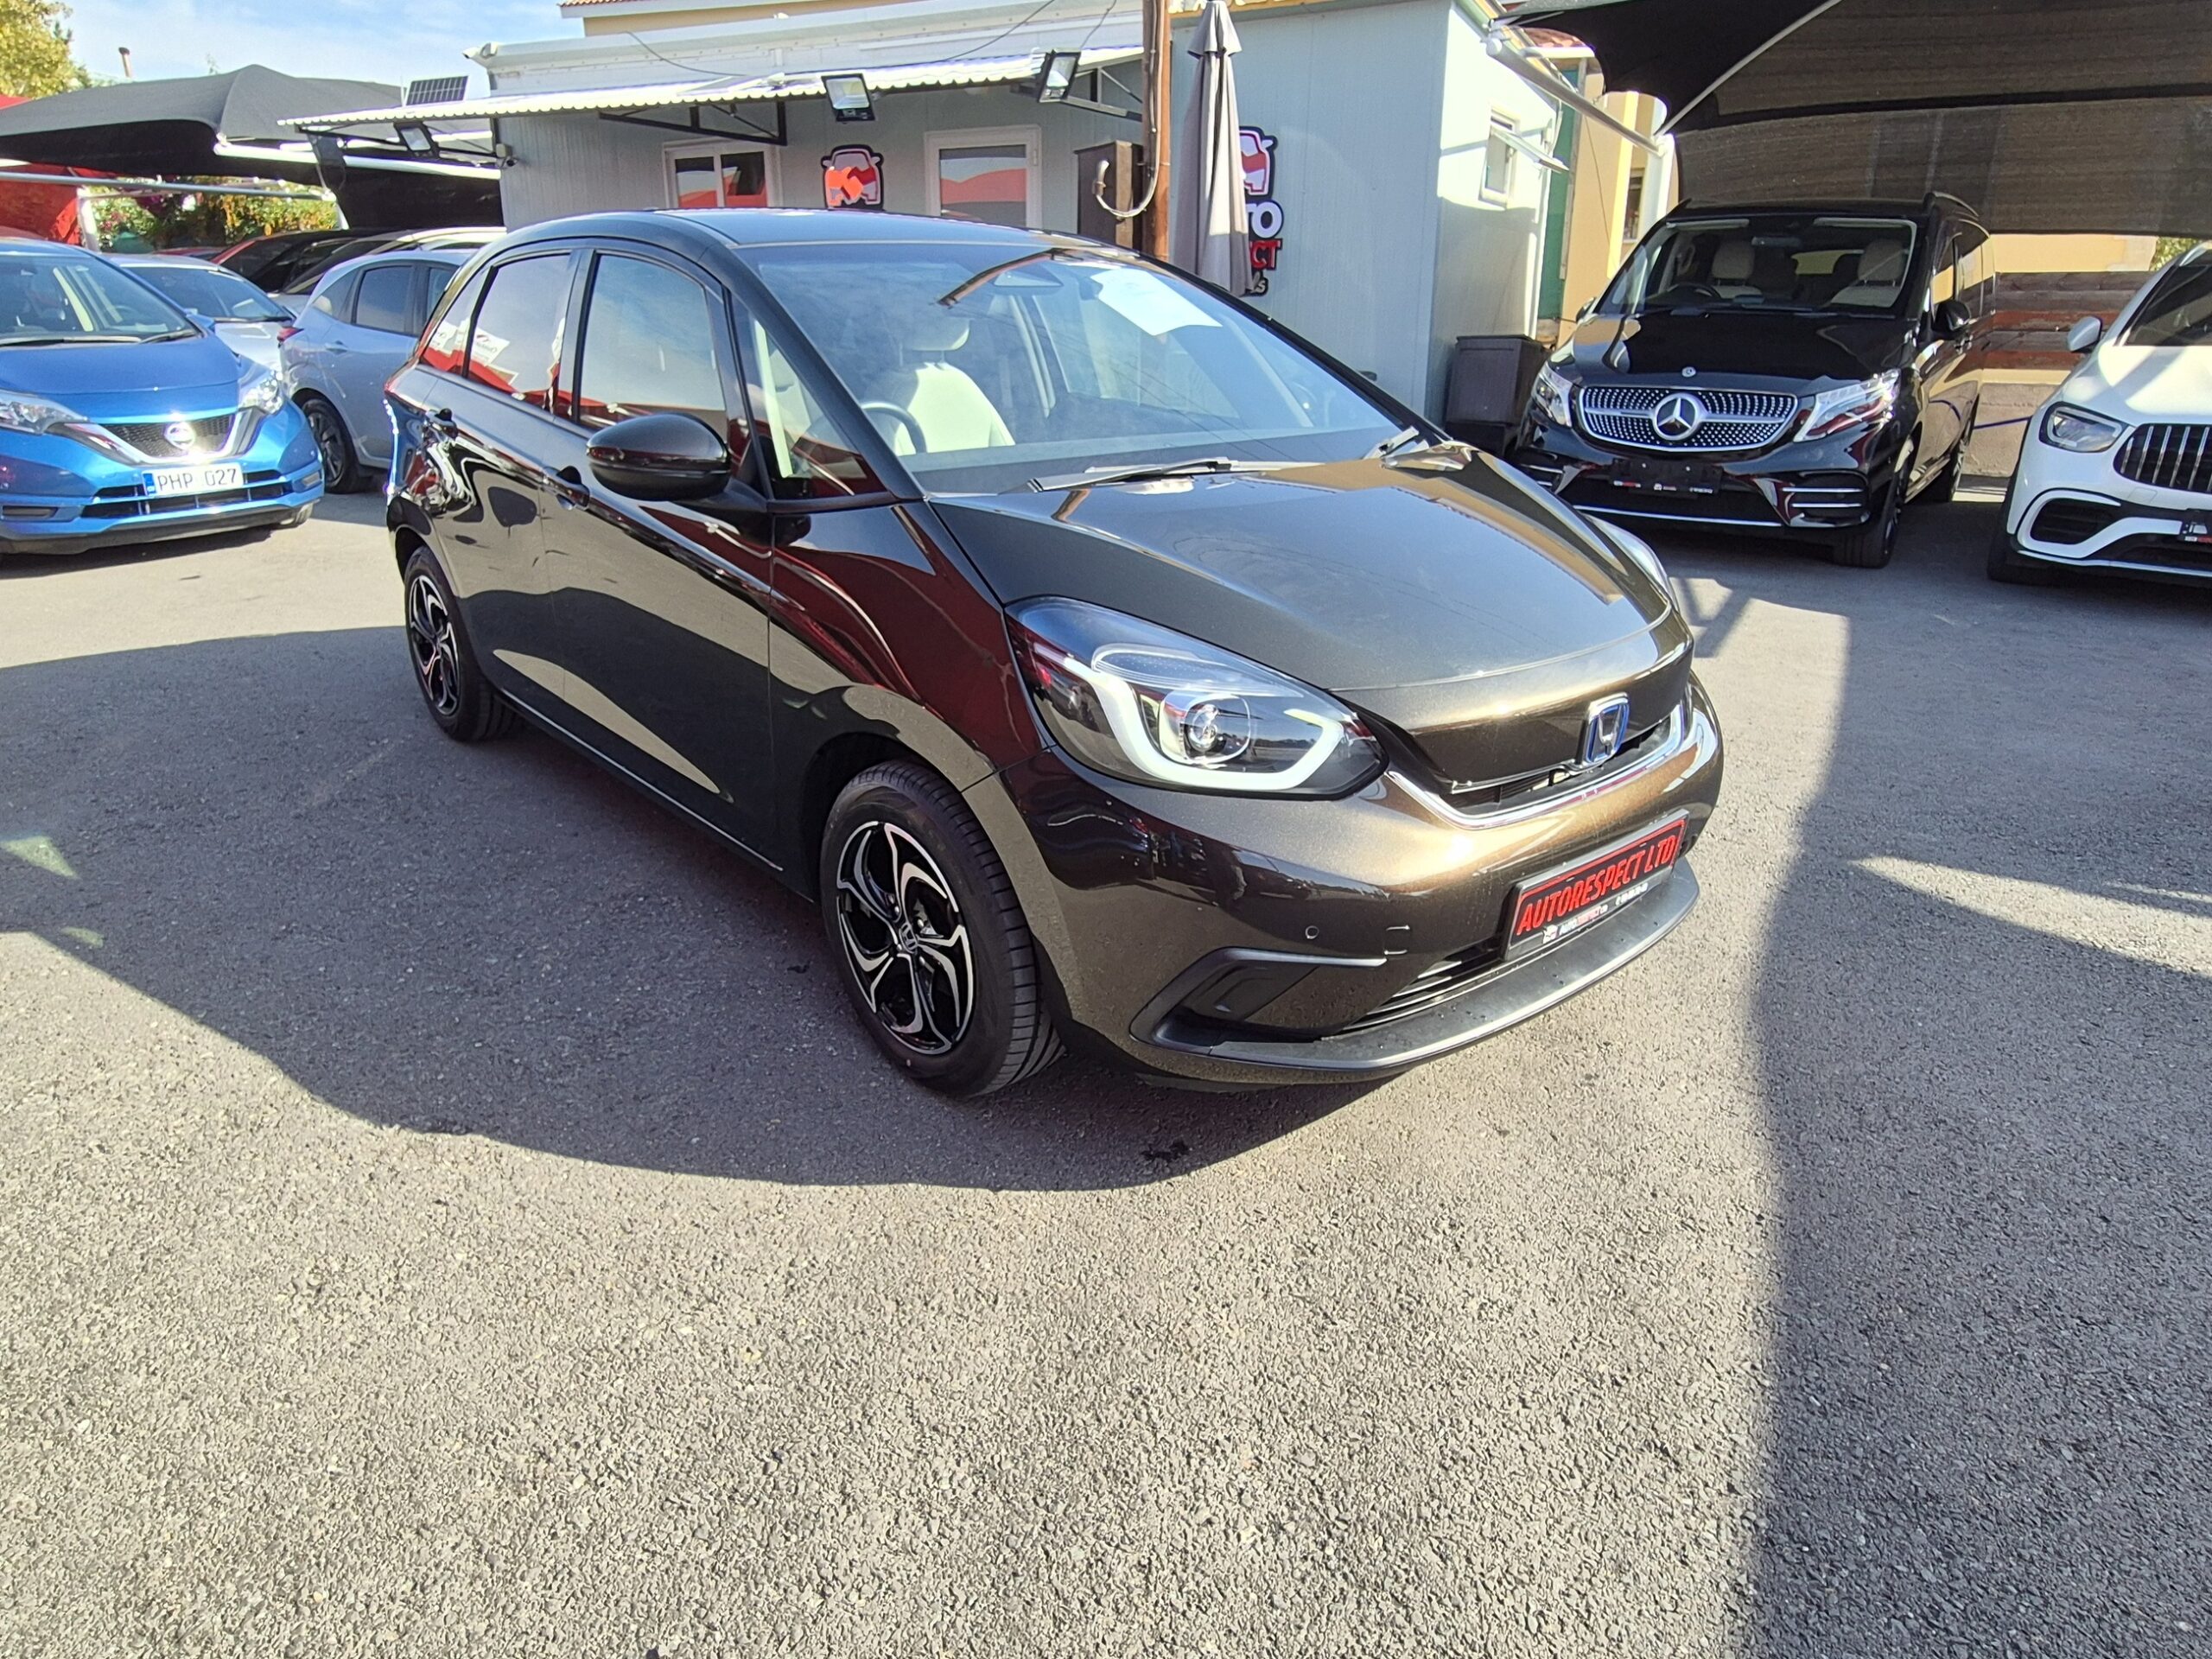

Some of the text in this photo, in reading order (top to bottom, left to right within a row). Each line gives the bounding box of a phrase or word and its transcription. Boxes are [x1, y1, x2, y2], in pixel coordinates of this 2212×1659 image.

[157, 468, 237, 491] PHP 027
[1516, 849, 1647, 936] AUTORESPECT
[1643, 835, 1678, 874] LTD
